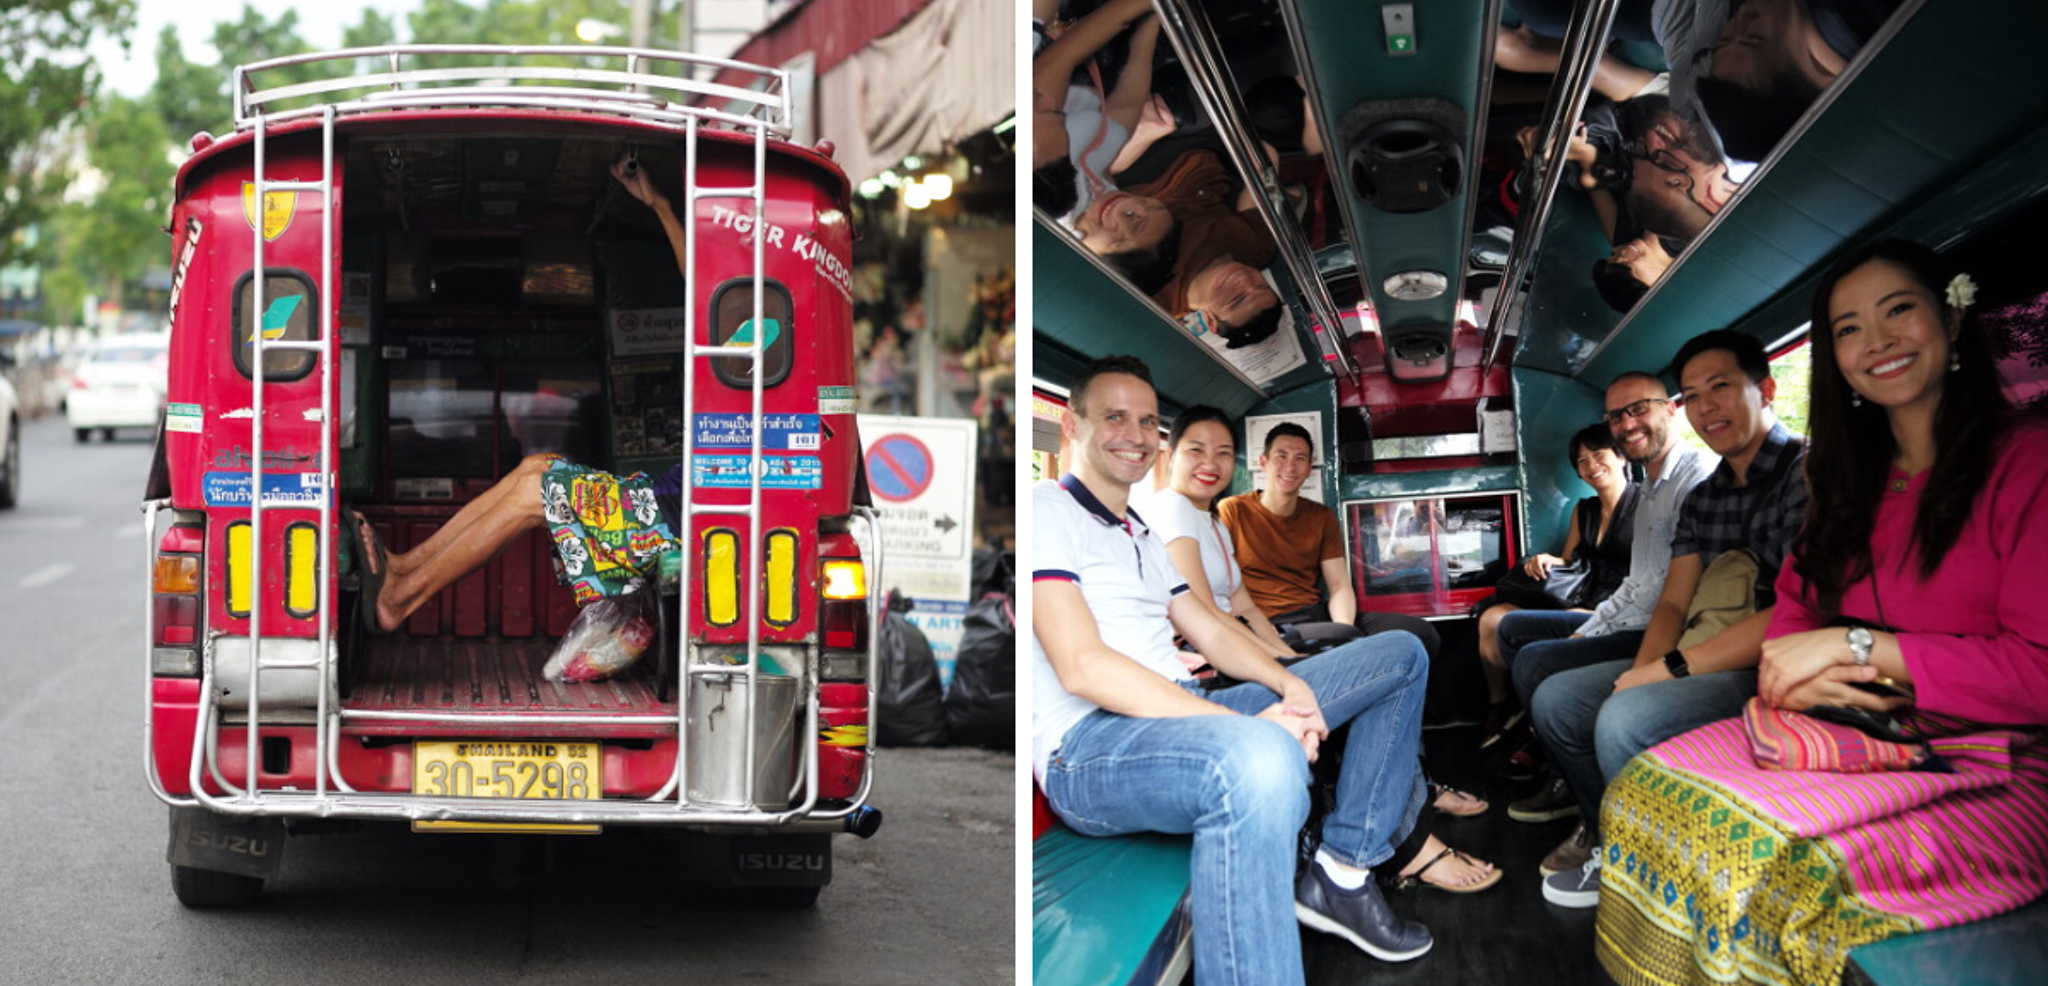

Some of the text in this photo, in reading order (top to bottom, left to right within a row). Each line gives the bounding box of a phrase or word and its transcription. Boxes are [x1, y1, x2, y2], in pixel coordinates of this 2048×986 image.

[792, 234, 854, 292] KINGDO
[456, 744, 588, 758] THAILAND 52
[425, 760, 588, 800] 30-5298
[740, 854, 823, 870] ISUZU
